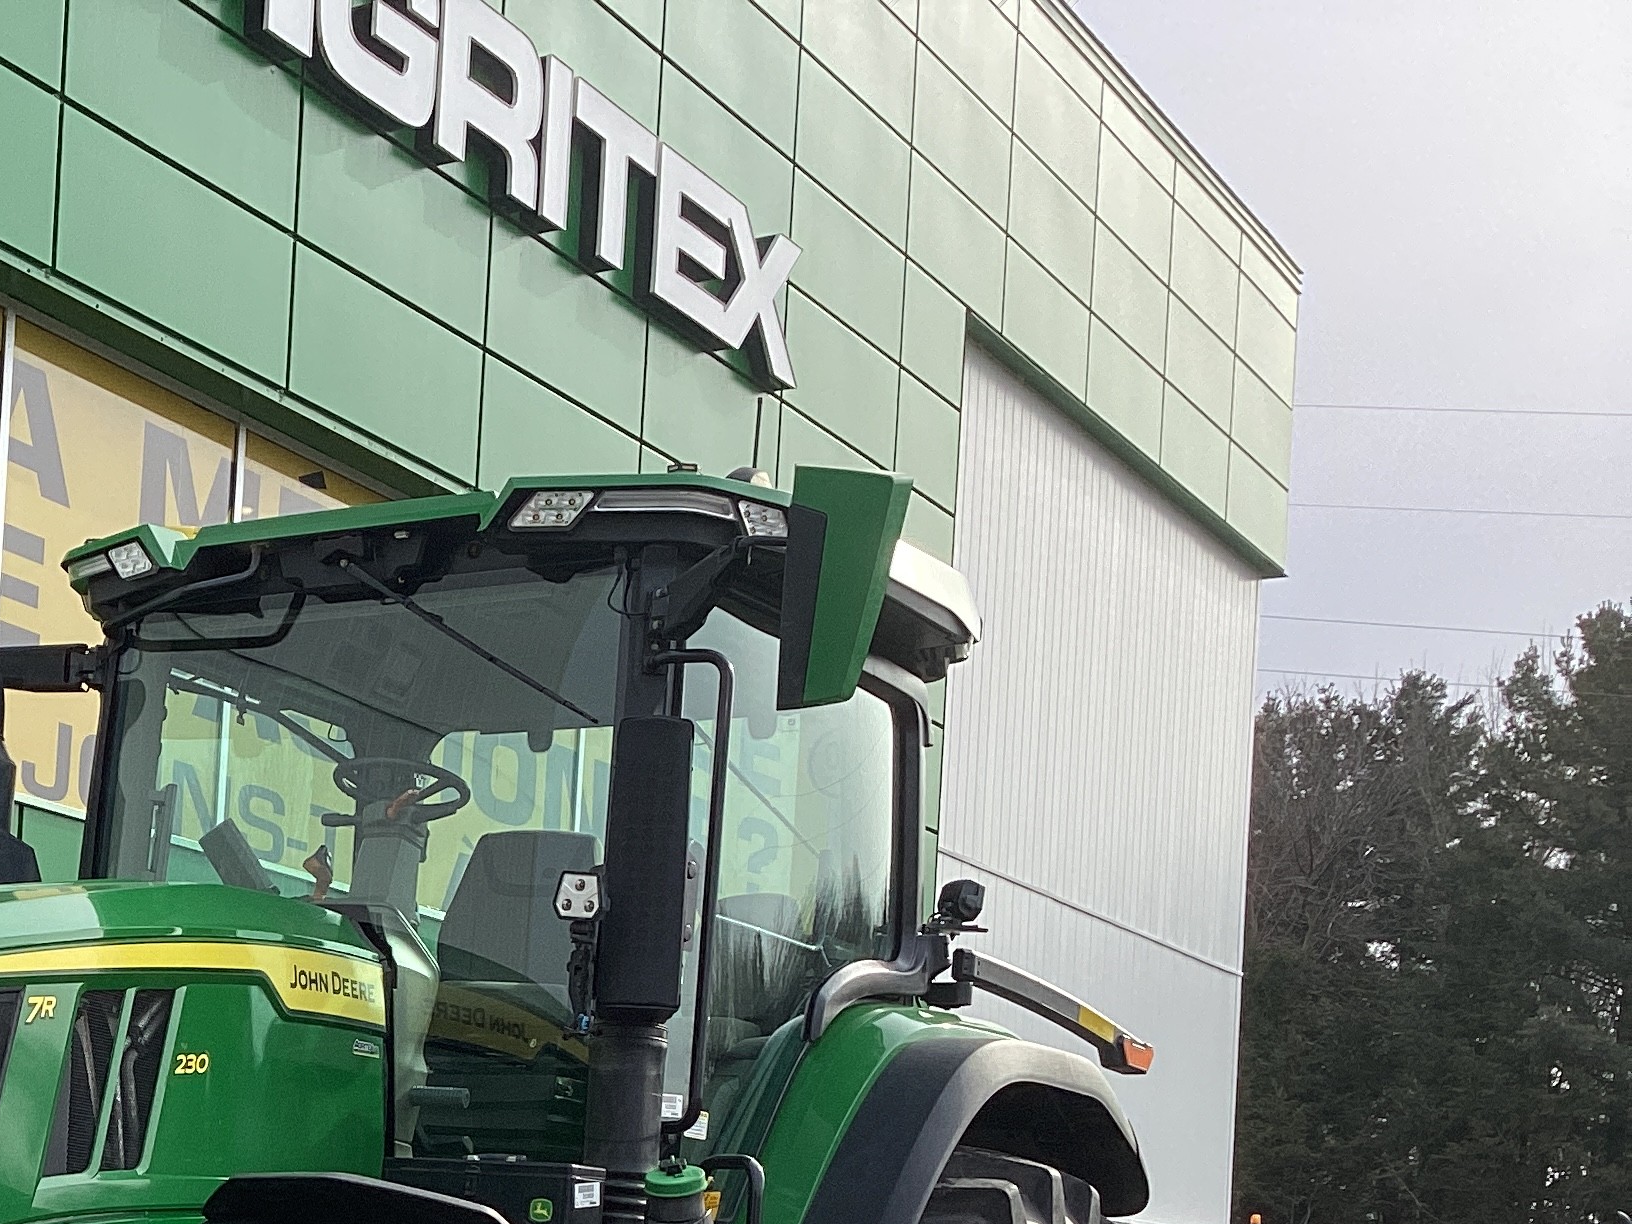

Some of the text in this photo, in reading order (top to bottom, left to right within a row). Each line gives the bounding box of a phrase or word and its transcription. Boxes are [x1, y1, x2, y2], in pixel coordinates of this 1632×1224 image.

[290, 965, 375, 1003] JOHN DEERE
[25, 996, 56, 1023] 7R
[174, 1053, 209, 1075] 230
